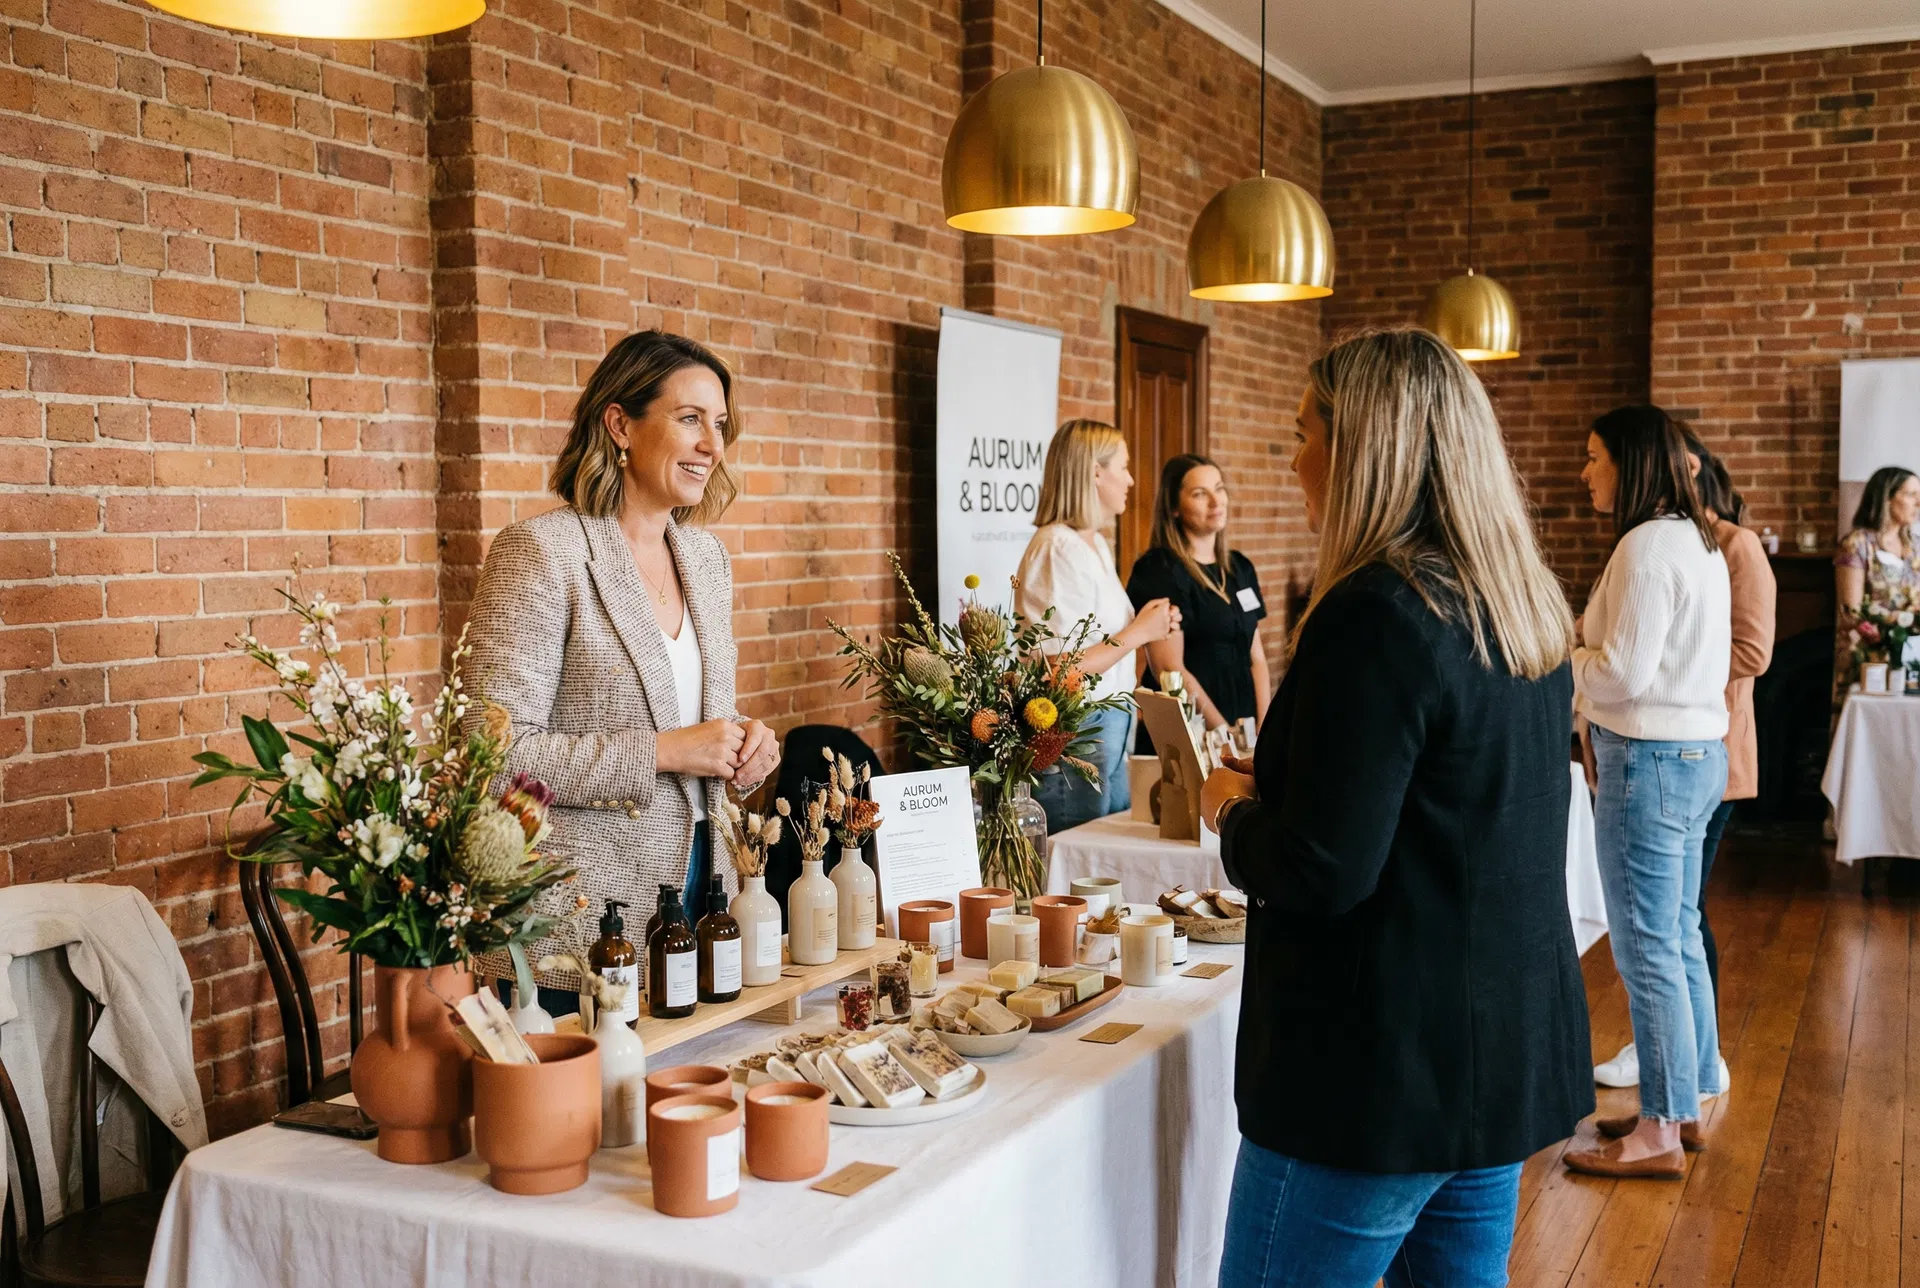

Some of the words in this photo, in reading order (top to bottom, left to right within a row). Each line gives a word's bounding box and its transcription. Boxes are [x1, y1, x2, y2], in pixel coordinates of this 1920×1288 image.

[968, 437, 1042, 470] AURUM
[960, 481, 973, 512] &
[981, 482, 1041, 512] BLOO
[903, 783, 942, 797] AURUM
[899, 801, 907, 812] &
[909, 795, 948, 811] BLOOM
